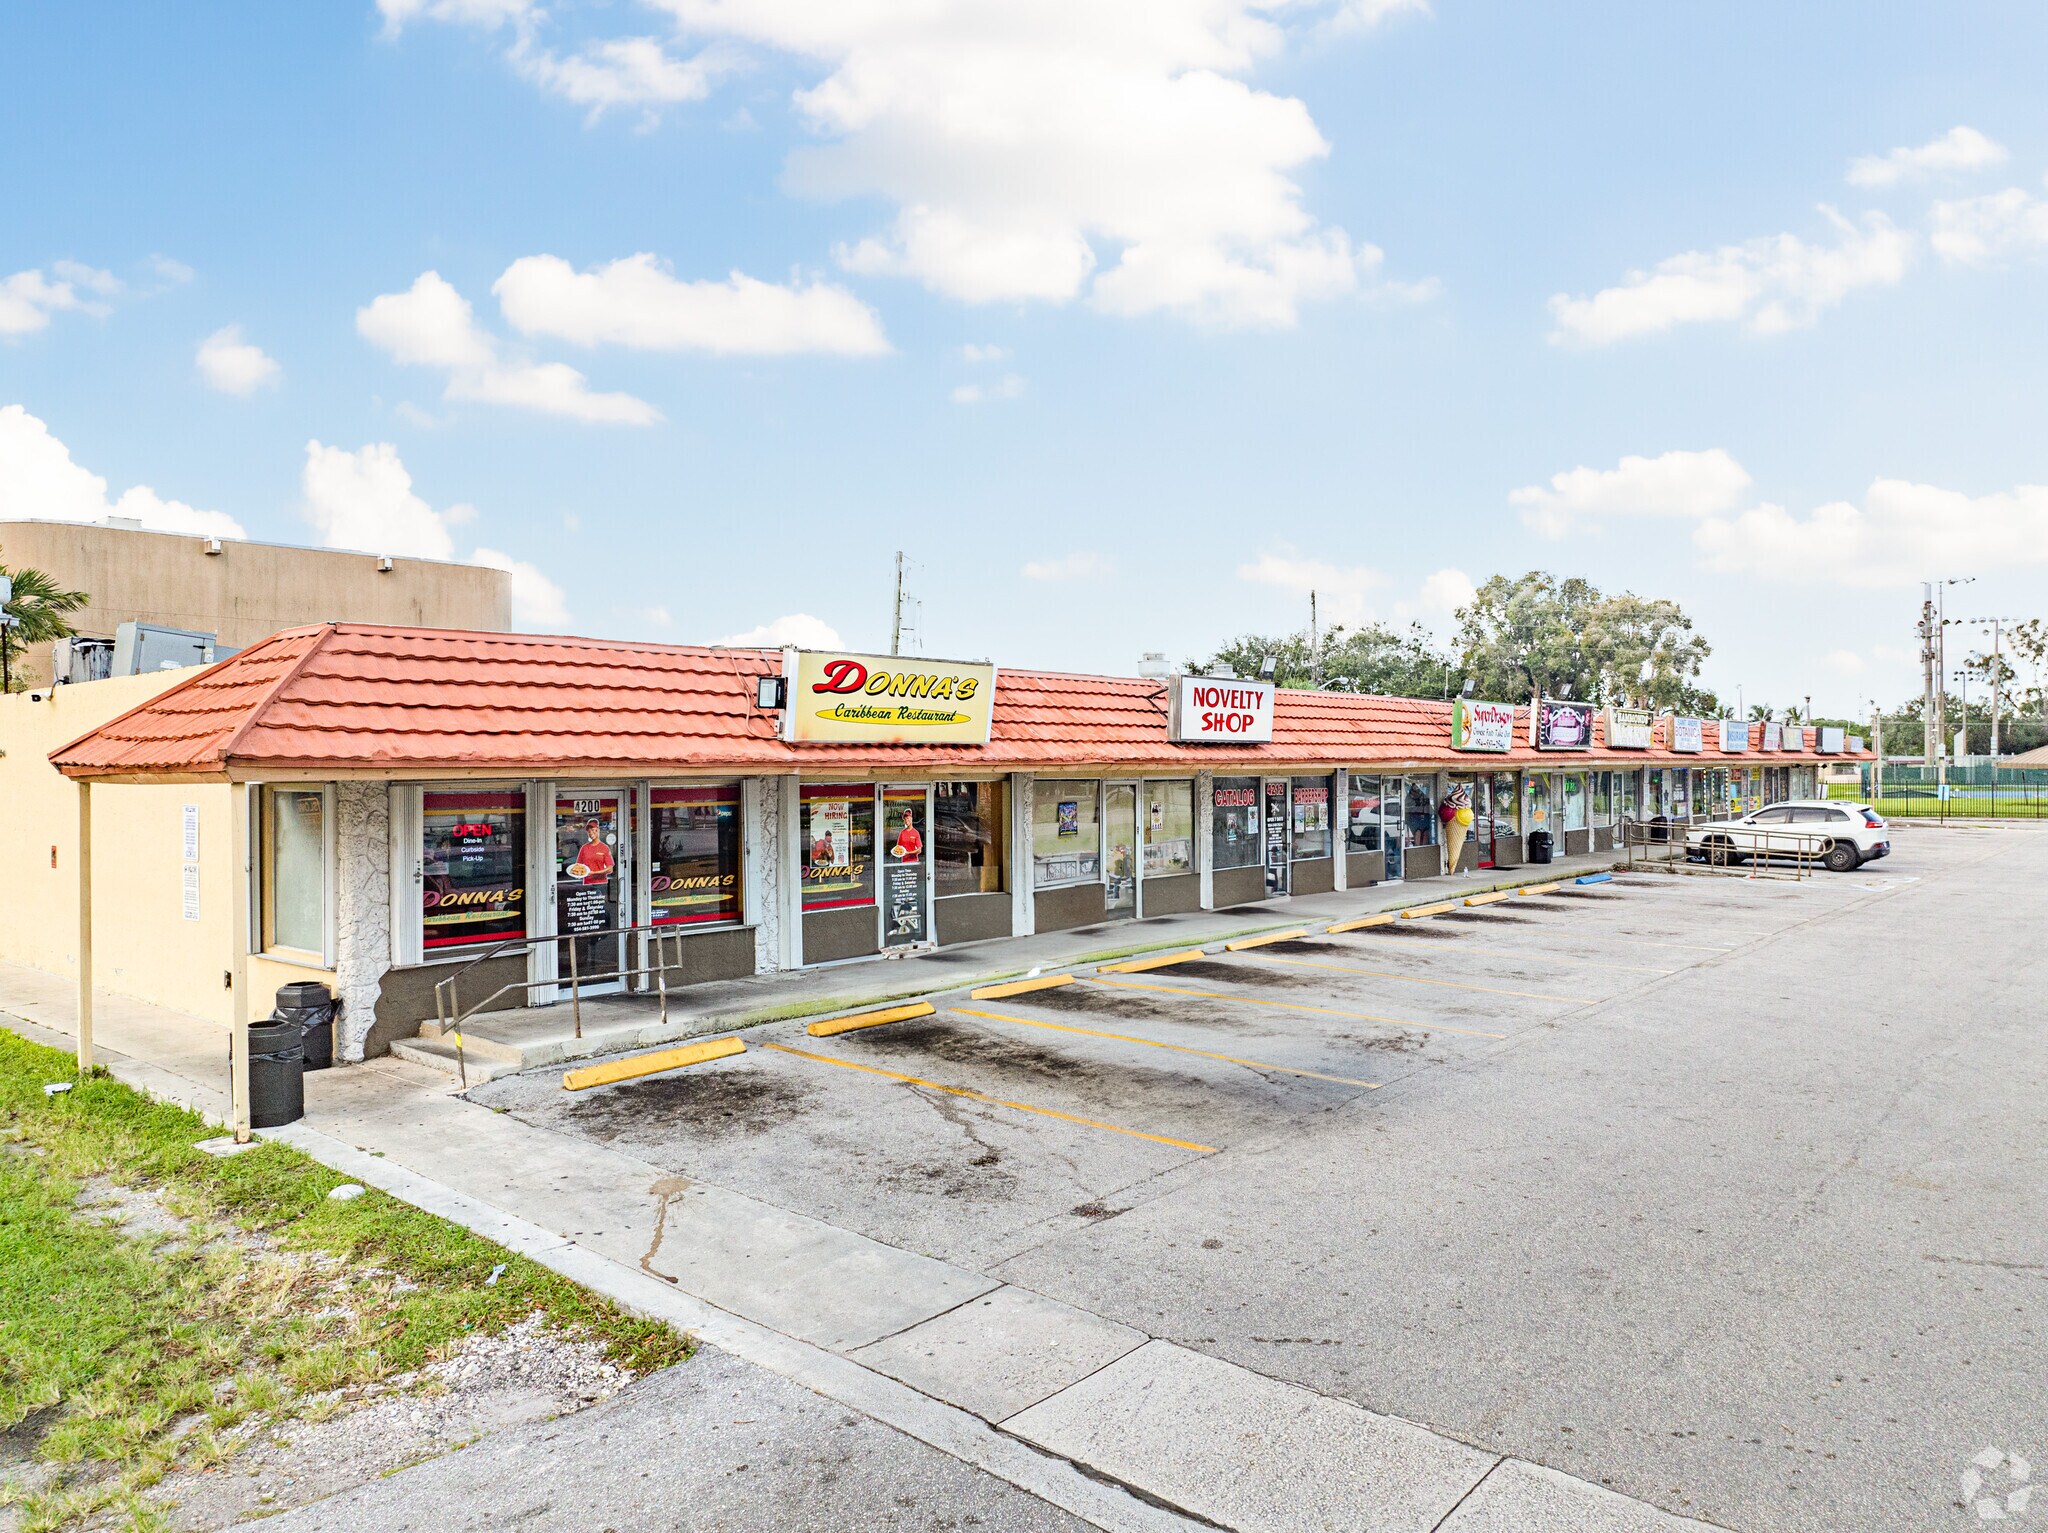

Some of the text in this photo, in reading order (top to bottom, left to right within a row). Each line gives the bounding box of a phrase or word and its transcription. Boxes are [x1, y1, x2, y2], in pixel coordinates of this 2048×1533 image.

[812, 660, 978, 700] DONNA'S
[1193, 687, 1264, 710] NOVELTY
[834, 703, 958, 722] Caribbean Restaurant
[1201, 712, 1254, 733] SHOP
[1267, 783, 1284, 796] 4212
[1294, 788, 1328, 804] BARBERSHOP
[574, 800, 600, 812] 4200
[1215, 789, 1255, 807] CATALOG
[828, 803, 844, 811] NOW
[824, 812, 848, 820] HIRING
[452, 824, 493, 837] OPEN
[651, 874, 735, 892] DONNA'S
[465, 909, 511, 920] Restaurant
